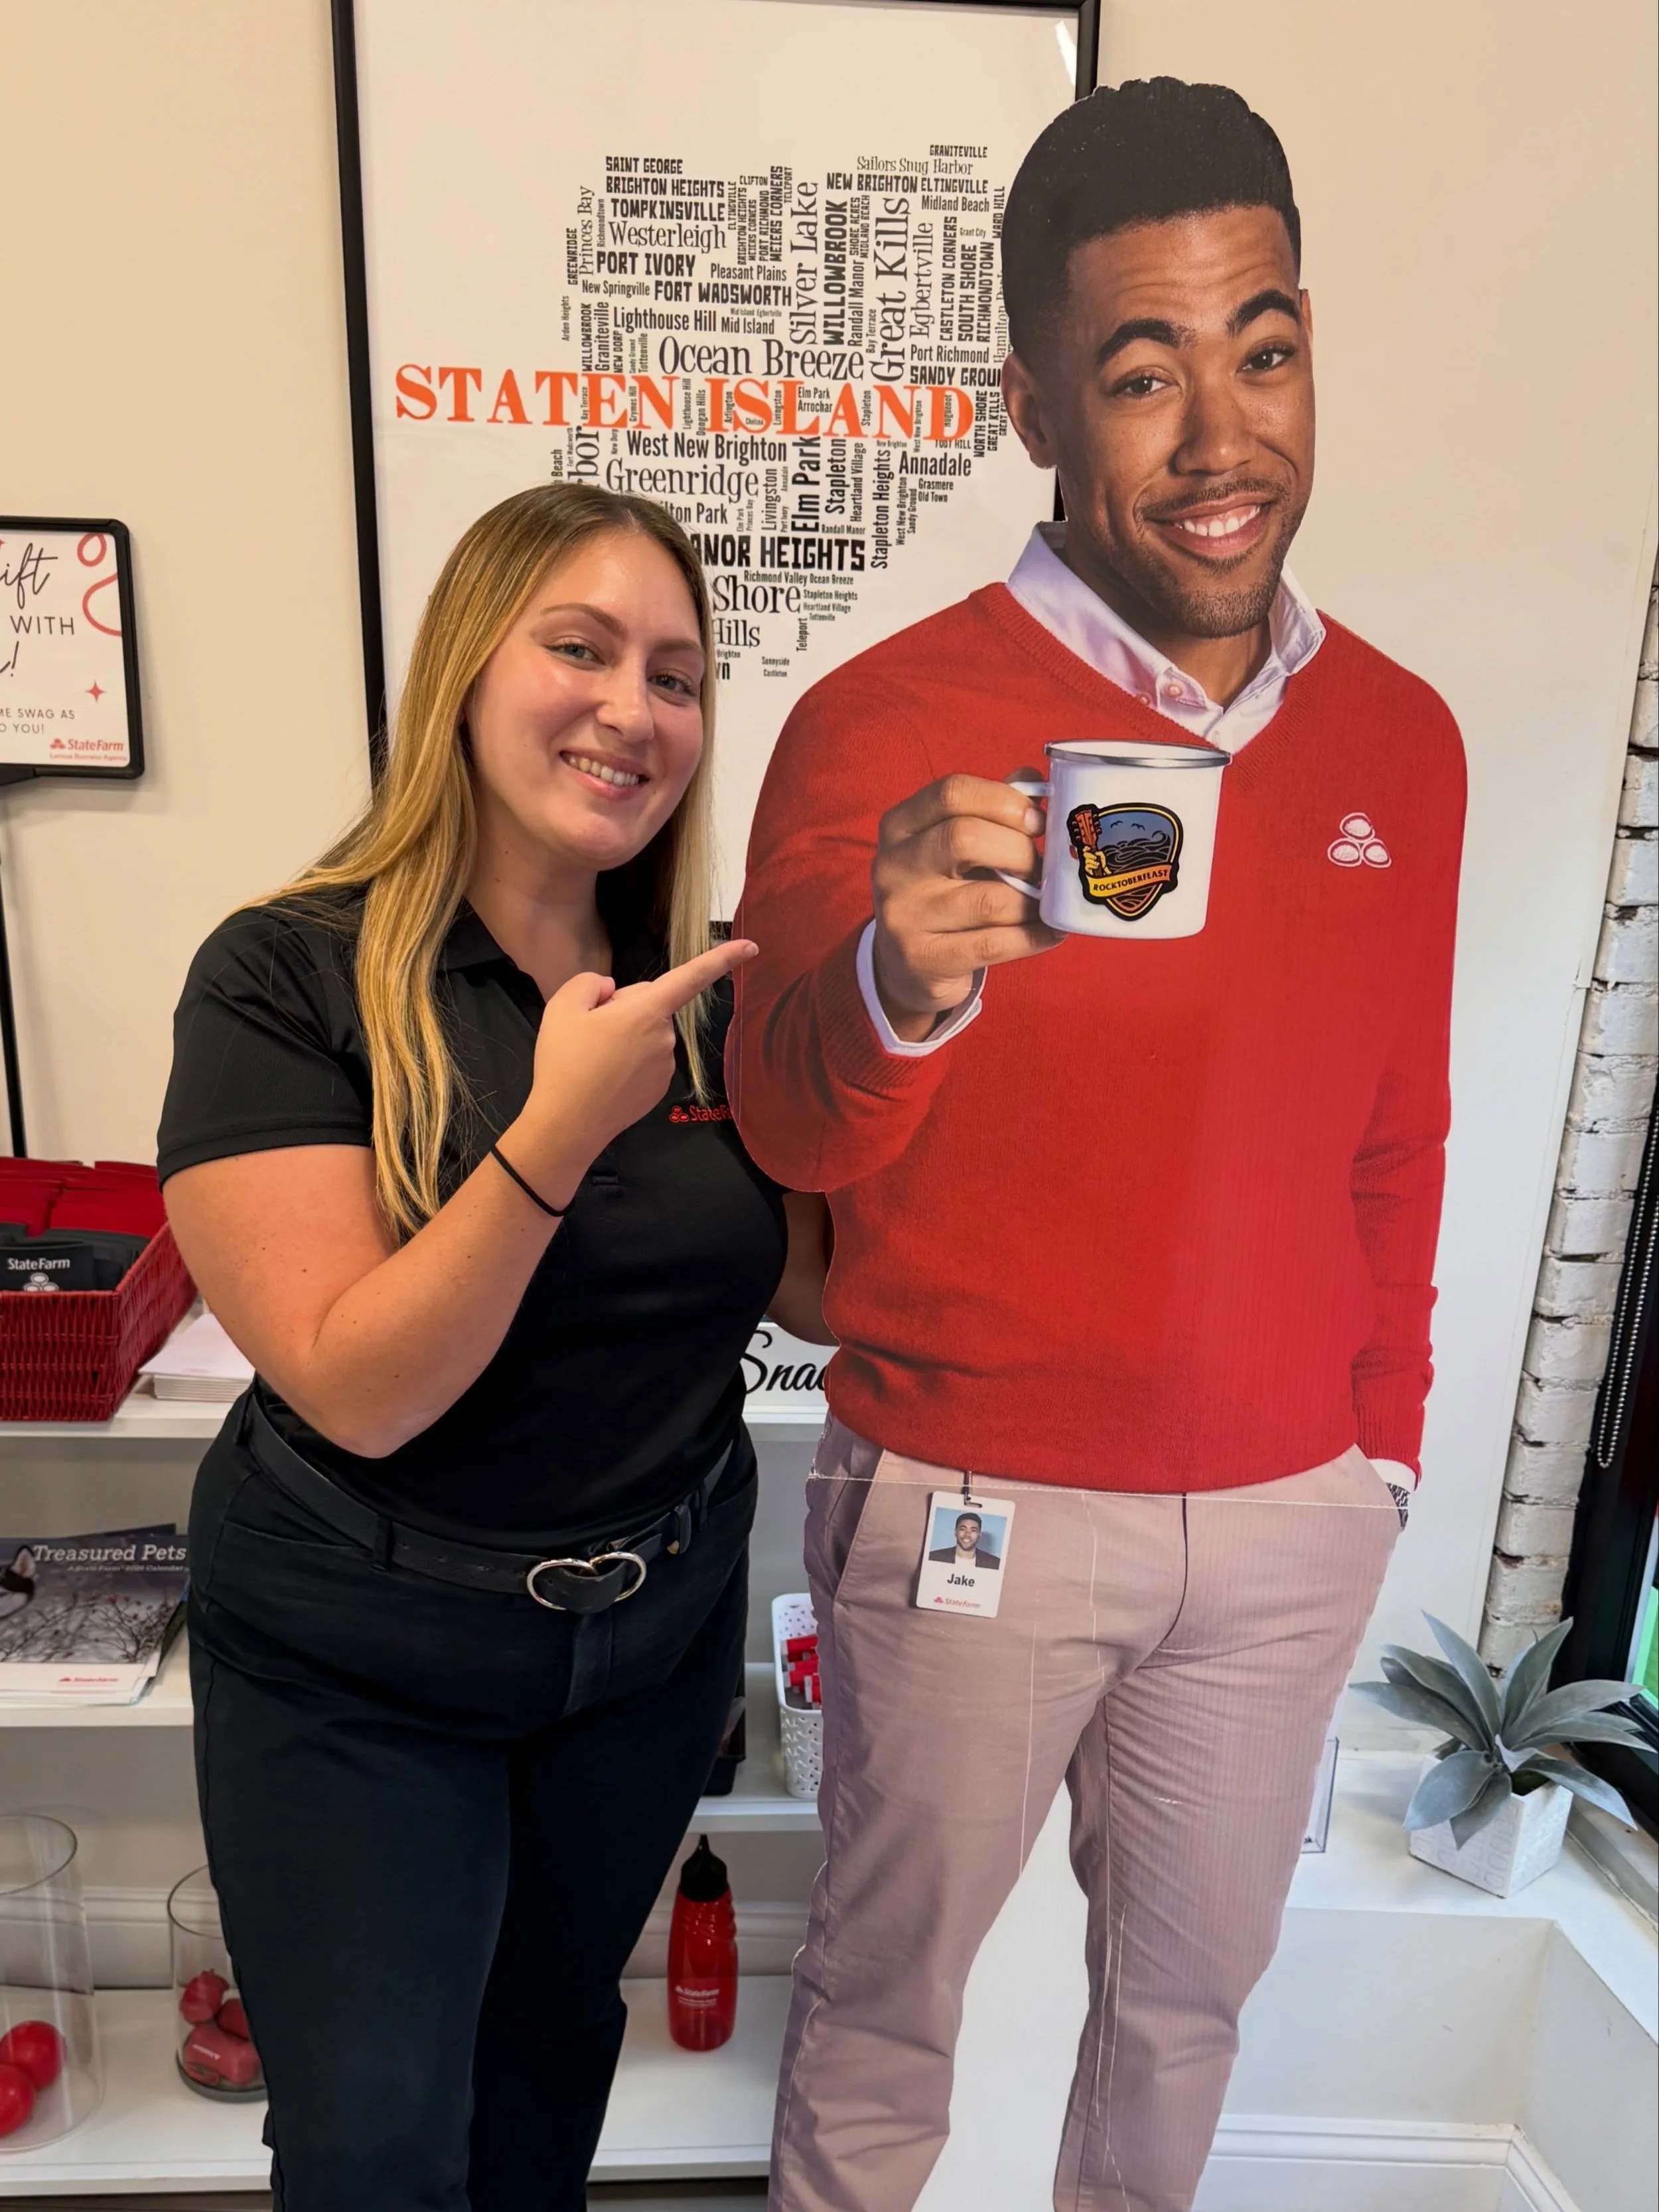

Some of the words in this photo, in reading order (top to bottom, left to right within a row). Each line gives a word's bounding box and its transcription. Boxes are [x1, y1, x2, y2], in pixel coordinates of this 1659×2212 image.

[929, 144, 987, 158] GRANITEVILLE
[606, 156, 639, 173] SAINT
[644, 158, 683, 175] GEORGE
[857, 155, 897, 173] Sailors
[899, 157, 929, 176] Snug
[932, 159, 974, 175] Harbor
[606, 176, 668, 196] BRIGHTON
[672, 179, 725, 198] HEIGHTS
[739, 175, 768, 186] CLIFTON
[770, 166, 783, 216] CORNERS
[784, 167, 792, 203] TELEPORT
[827, 173, 853, 190] NEW
[857, 173, 918, 193] BRIGHTON
[920, 178, 988, 194] ELTINGVILLE
[577, 186, 595, 216] Bay
[611, 198, 725, 221] TOMPKINSVILLE
[728, 181, 737, 230] ELTINGVILLE
[738, 187, 747, 224] HEIGHTS
[759, 189, 770, 235] RICHMOND
[850, 197, 861, 224] ACRES
[861, 195, 870, 221] BEACH
[922, 195, 958, 212] Midland
[962, 196, 989, 212] Beach
[993, 186, 1005, 212] HILL
[597, 198, 605, 247] Richmondtown
[748, 199, 757, 233] CORNERS
[790, 181, 819, 254] Lake
[579, 220, 594, 276] Princes
[609, 220, 727, 254] Westerleigh
[737, 226, 747, 265] BRIGHTON
[748, 235, 757, 261] MEIERS
[758, 237, 769, 261] PORT
[769, 220, 783, 262] MEIERS
[849, 228, 859, 256] SHORE
[860, 223, 869, 258] MIDLAND
[873, 198, 912, 281] Kills
[942, 216, 957, 269] CORNERS
[566, 228, 578, 285] GREENRIDGE
[597, 251, 638, 275] PORT
[644, 254, 695, 277] IVORY
[959, 244, 977, 290] SHORE
[711, 263, 754, 281] Pleasant
[757, 265, 787, 281] Plains
[823, 199, 848, 345] WILLOWBROOK
[848, 259, 865, 298] Manor
[909, 222, 935, 340] Egbertville
[582, 279, 601, 295] New
[603, 280, 650, 298] Springville
[654, 280, 693, 302] FORT
[698, 282, 792, 307] WADSWORTH
[976, 242, 994, 342] RICHMONDTOWN
[561, 295, 571, 321] Heights
[789, 261, 818, 345] Silver
[940, 273, 955, 341] CASTLETON
[613, 306, 689, 333] Lighthouse
[694, 309, 716, 332] Hill
[721, 316, 740, 333] Mid
[743, 317, 775, 335] Island
[847, 301, 863, 347] Randall
[865, 309, 877, 337] Terrace
[958, 294, 975, 342] SOUTH
[581, 303, 593, 372] WILLOWBROOK
[593, 301, 610, 372] Graniteville
[613, 331, 623, 353] DORP
[865, 337, 877, 354] Bay
[869, 291, 906, 382] Great
[613, 354, 623, 373] NEW
[638, 332, 648, 373] Tottenville
[659, 335, 753, 375] Ocean
[761, 338, 864, 380] Breeze
[910, 344, 933, 362] Port
[937, 345, 989, 364] Richmond
[682, 378, 691, 390] Hill
[910, 366, 956, 386] SANDY
[396, 363, 680, 430] STATEN
[705, 377, 974, 441] ISLAND
[798, 386, 811, 398] Elm
[813, 388, 830, 400] Park
[798, 400, 833, 413] Arrochar
[975, 390, 987, 421] SHORE
[989, 392, 1000, 419] KILLS
[773, 390, 784, 425] Livingston
[861, 390, 871, 427] Stapleton
[626, 430, 668, 457] West
[674, 432, 709, 458] New
[715, 433, 787, 467] Brighton
[974, 425, 986, 458] NORTH
[987, 423, 999, 451] GREAT
[550, 449, 563, 477] Beach
[792, 436, 821, 486] Park
[851, 443, 866, 475] Village
[899, 450, 972, 477] Annadale
[606, 457, 758, 504] Greenridge
[824, 439, 850, 514] Stapleton
[872, 449, 895, 501] Heights
[918, 478, 954, 490] Grasmere
[761, 469, 781, 530] Livingston
[850, 477, 863, 522] Heartland
[897, 477, 908, 508] Brighton
[908, 488, 918, 512] Ground
[918, 491, 929, 502] Old
[931, 492, 948, 502] Town
[697, 502, 728, 524] Park
[791, 494, 820, 532] Elm
[897, 510, 906, 526] New
[907, 512, 918, 534] Sandy
[822, 524, 844, 534] Randall
[846, 525, 865, 536] Manor
[871, 505, 893, 569] Stapleton
[896, 528, 906, 546] West
[760, 536, 865, 571] HEIGHTS
[744, 570, 782, 583] Richmond
[784, 572, 808, 587] Valley
[810, 573, 830, 584] Ocean
[832, 575, 854, 585] Breeze
[713, 575, 801, 614] Shore
[804, 589, 833, 601] Stapleton
[834, 591, 858, 603] Heights
[10, 615, 75, 635] WITH
[796, 617, 810, 652] Teleport
[18, 708, 54, 719] SWAG
[61, 709, 75, 720] AS
[13, 723, 44, 734] YOU!
[33, 1544, 137, 1562] Treasured
[141, 1544, 187, 1561] Pets
[947, 1574, 975, 1587] Jake
